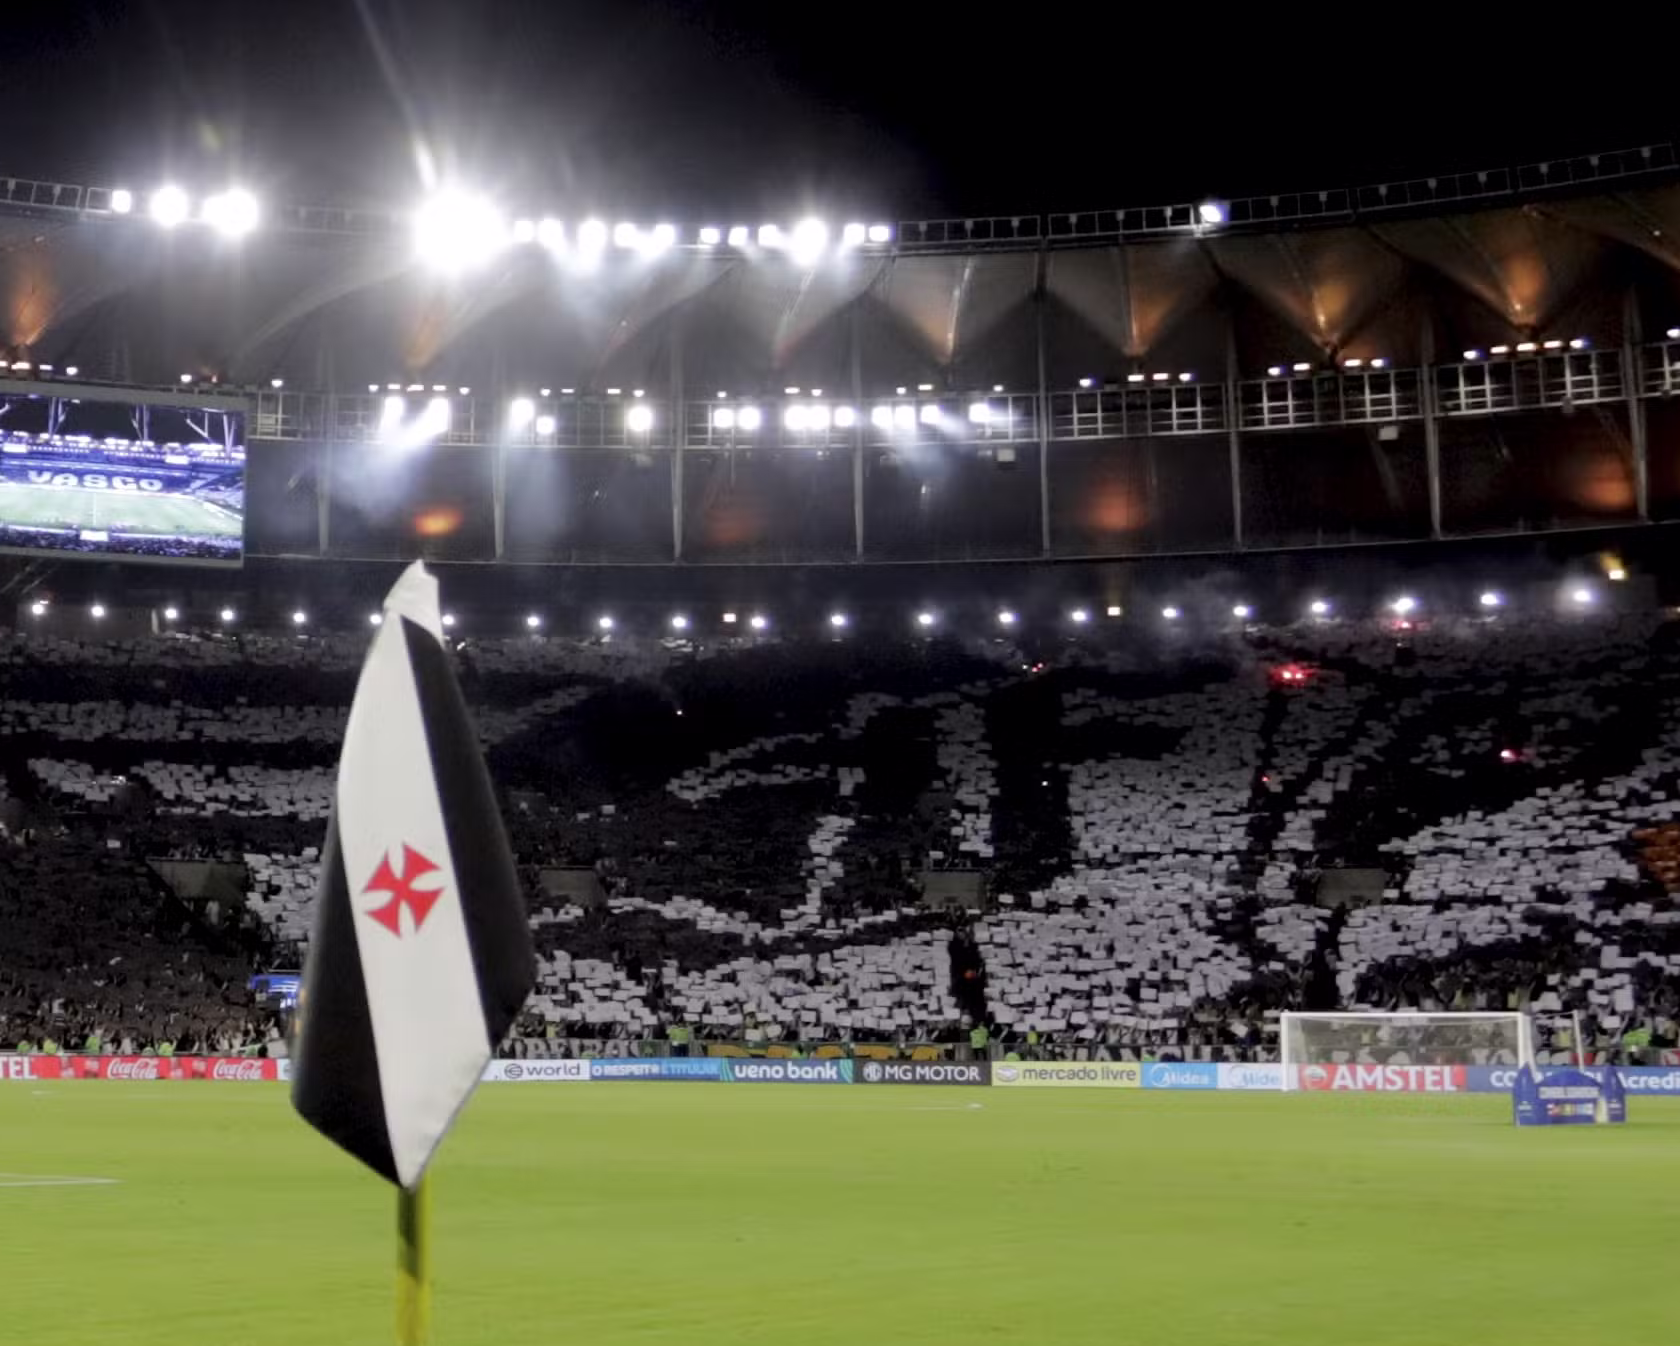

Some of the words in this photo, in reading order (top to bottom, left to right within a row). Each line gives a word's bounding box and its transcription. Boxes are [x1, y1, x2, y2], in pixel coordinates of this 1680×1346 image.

[27, 470, 163, 492] VASCO
[527, 1063, 580, 1076] world
[735, 1064, 783, 1079] ueno
[787, 1061, 838, 1079] bank
[885, 1066, 912, 1080] MG
[915, 1066, 981, 1081] MOTOR
[1023, 1063, 1097, 1080] mercado
[1101, 1063, 1136, 1081] livre
[1157, 1067, 1209, 1086] Midea
[1332, 1065, 1457, 1091] AMSTEL
